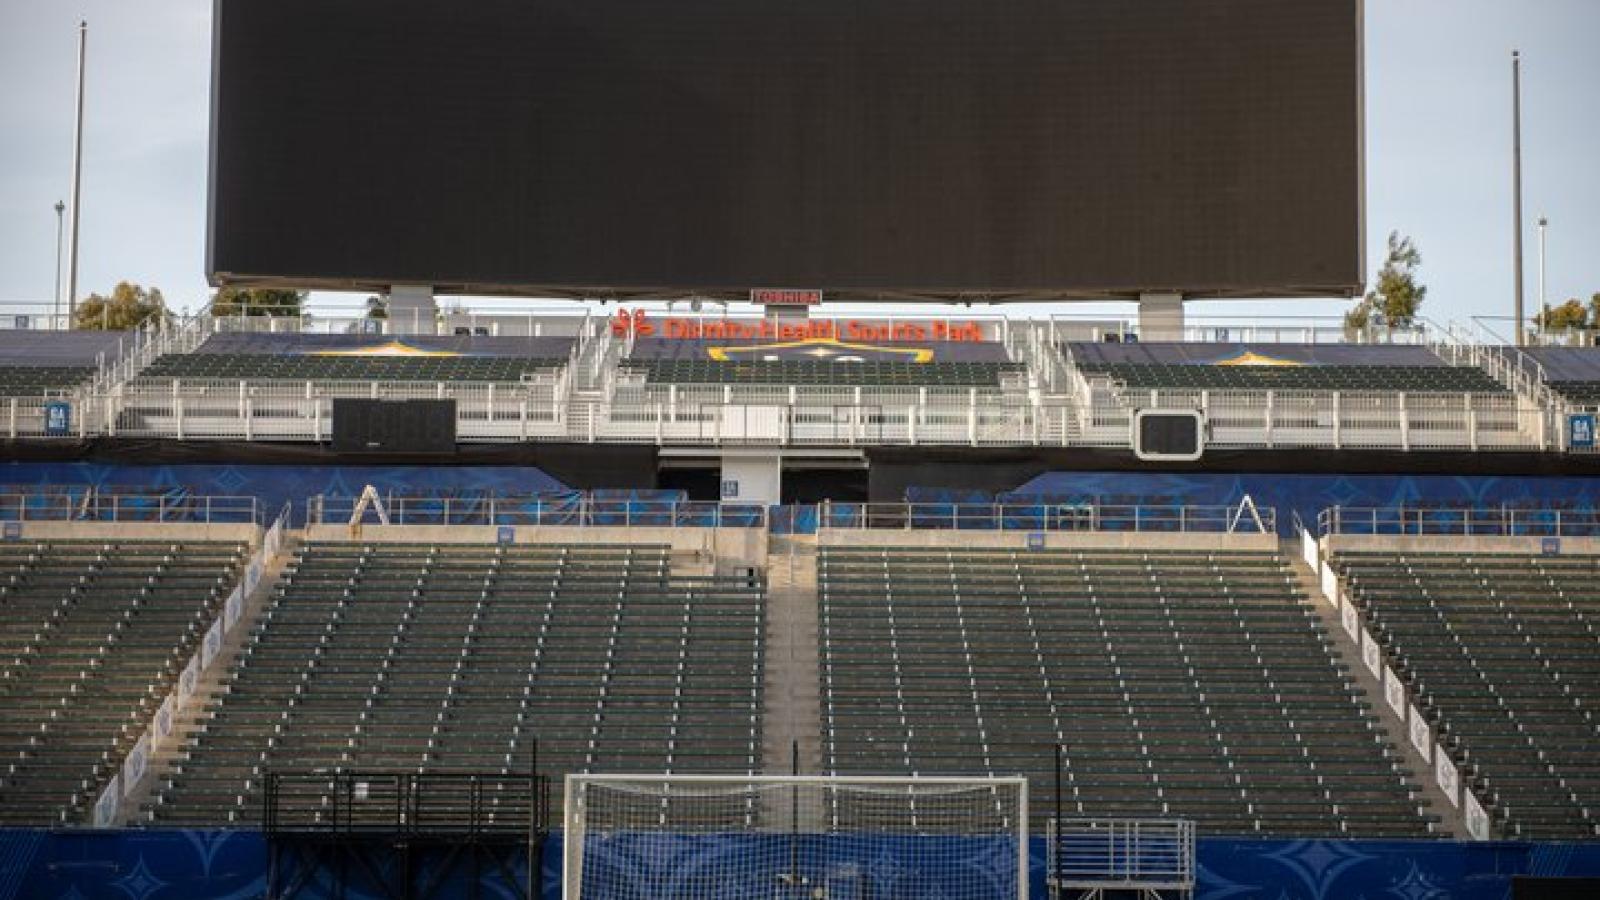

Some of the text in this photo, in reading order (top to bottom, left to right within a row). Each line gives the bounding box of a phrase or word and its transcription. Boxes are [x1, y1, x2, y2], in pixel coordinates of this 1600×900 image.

[753, 291, 819, 304] TOSHIBA
[760, 318, 841, 341] Health
[848, 319, 926, 341] Sports
[932, 319, 984, 342] Park
